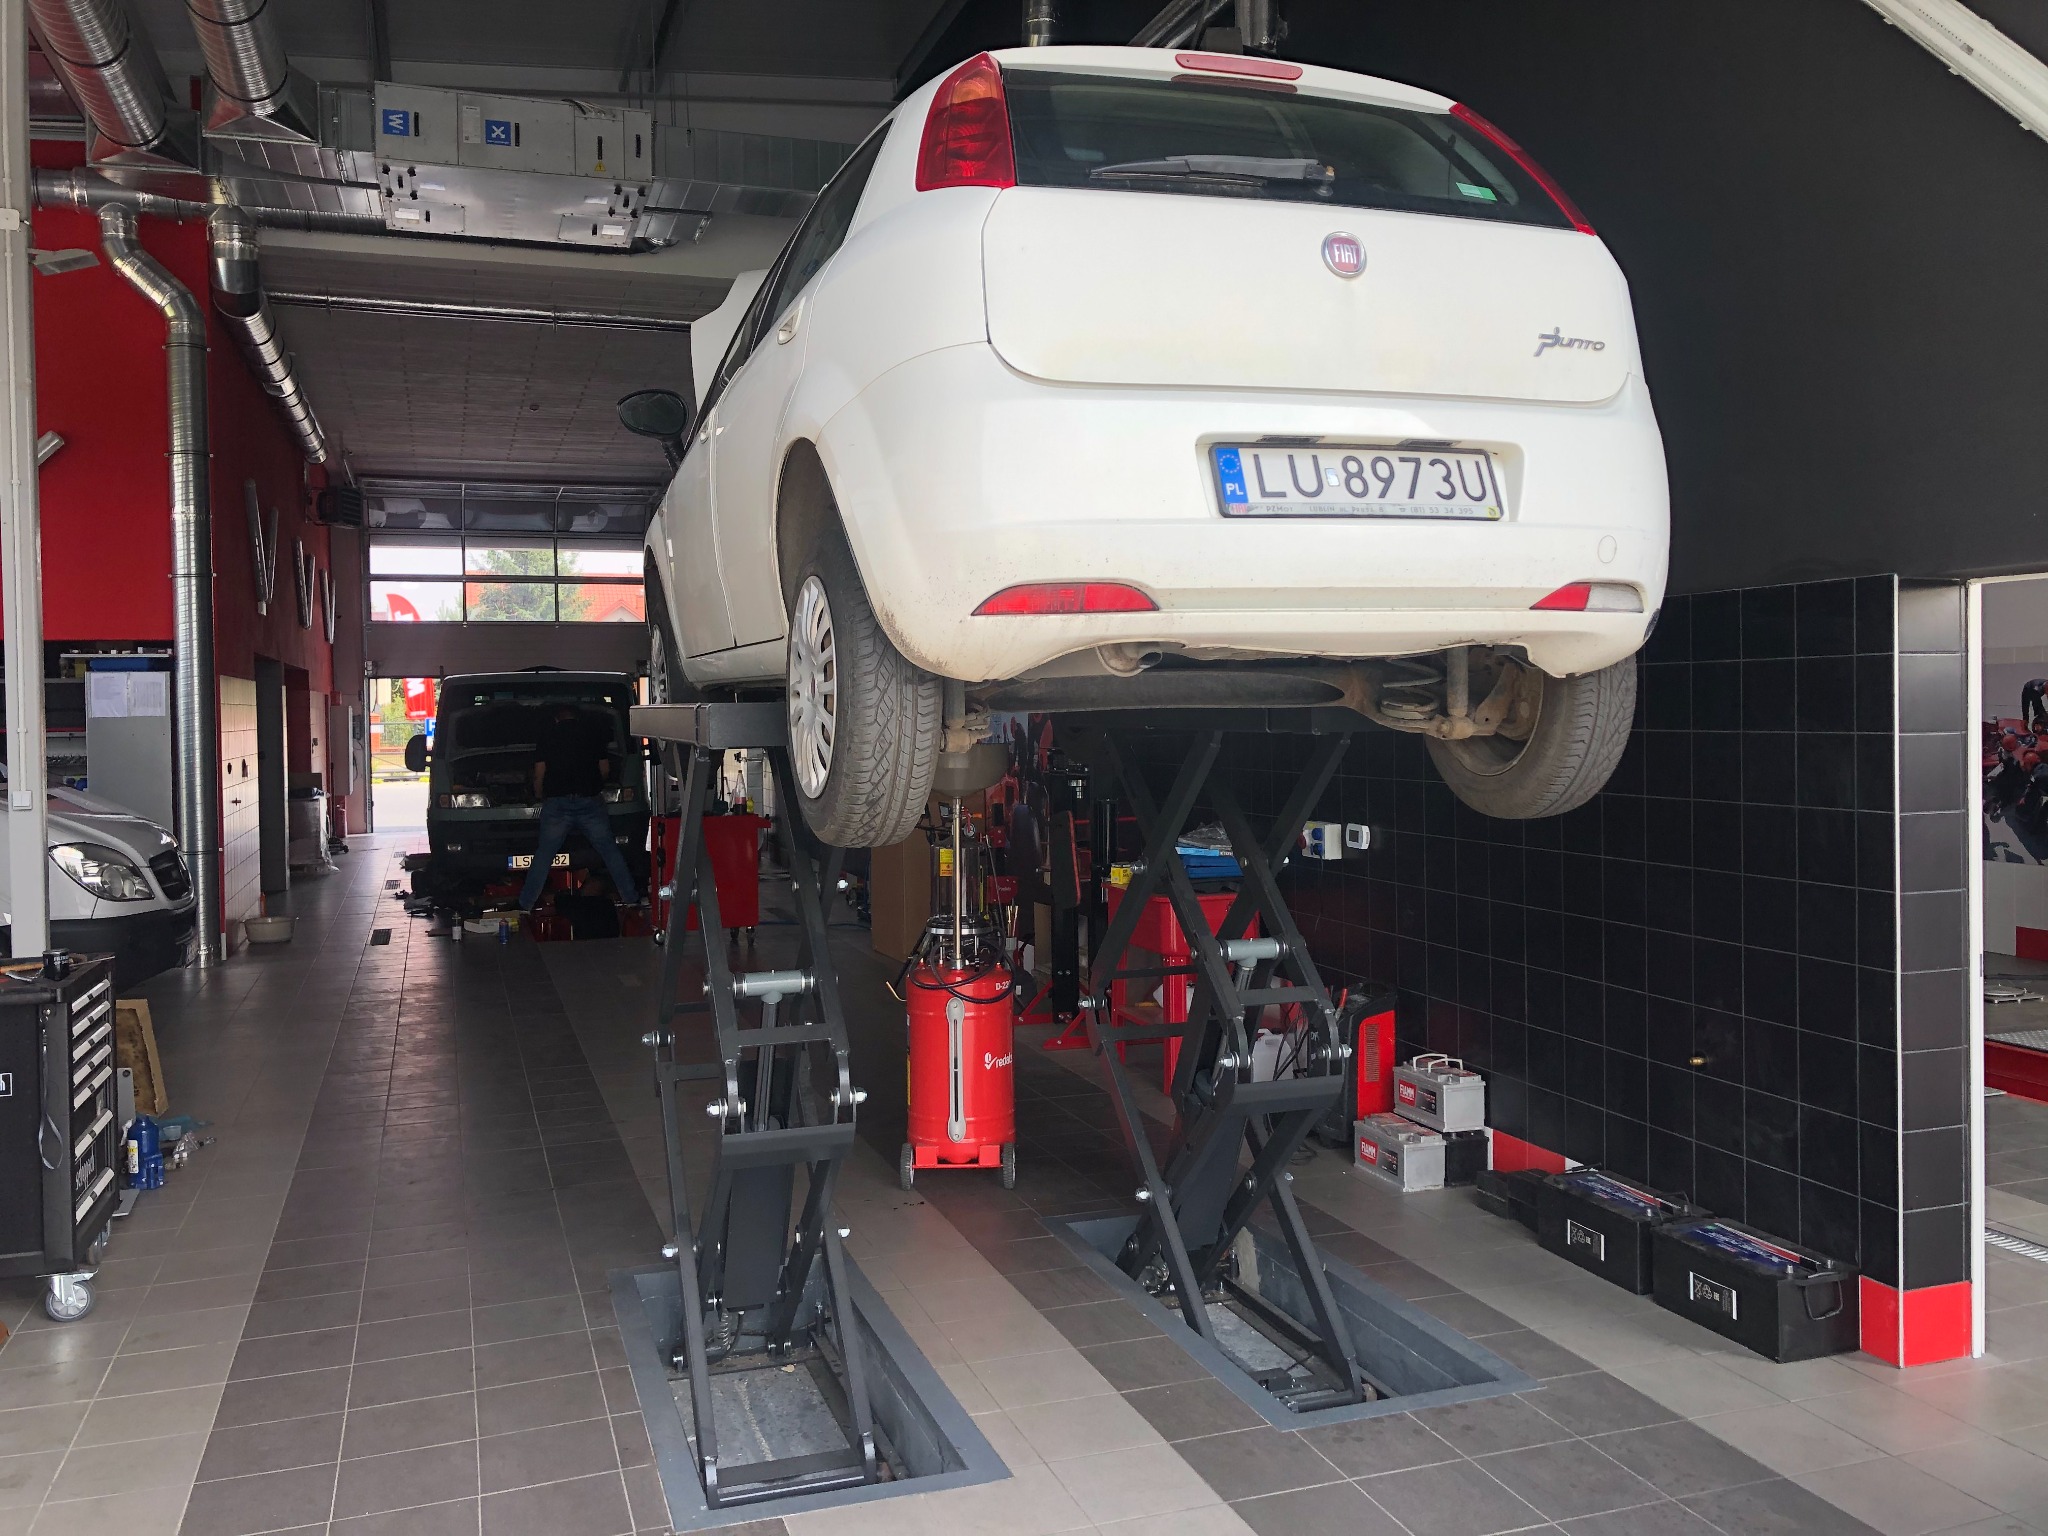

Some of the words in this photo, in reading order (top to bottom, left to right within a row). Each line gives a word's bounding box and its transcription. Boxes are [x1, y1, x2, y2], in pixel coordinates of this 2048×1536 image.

[1333, 243, 1358, 264] FIAT
[1253, 453, 1324, 499] LU
[1340, 455, 1488, 502] 8973U
[1225, 482, 1244, 496] PL
[1429, 506, 1439, 514] 53
[1458, 507, 1474, 515] 395
[515, 856, 533, 867] LS
[995, 980, 1011, 991] D-22
[1399, 1083, 1415, 1099] FIAMM
[1361, 1141, 1376, 1157] FIAMM
